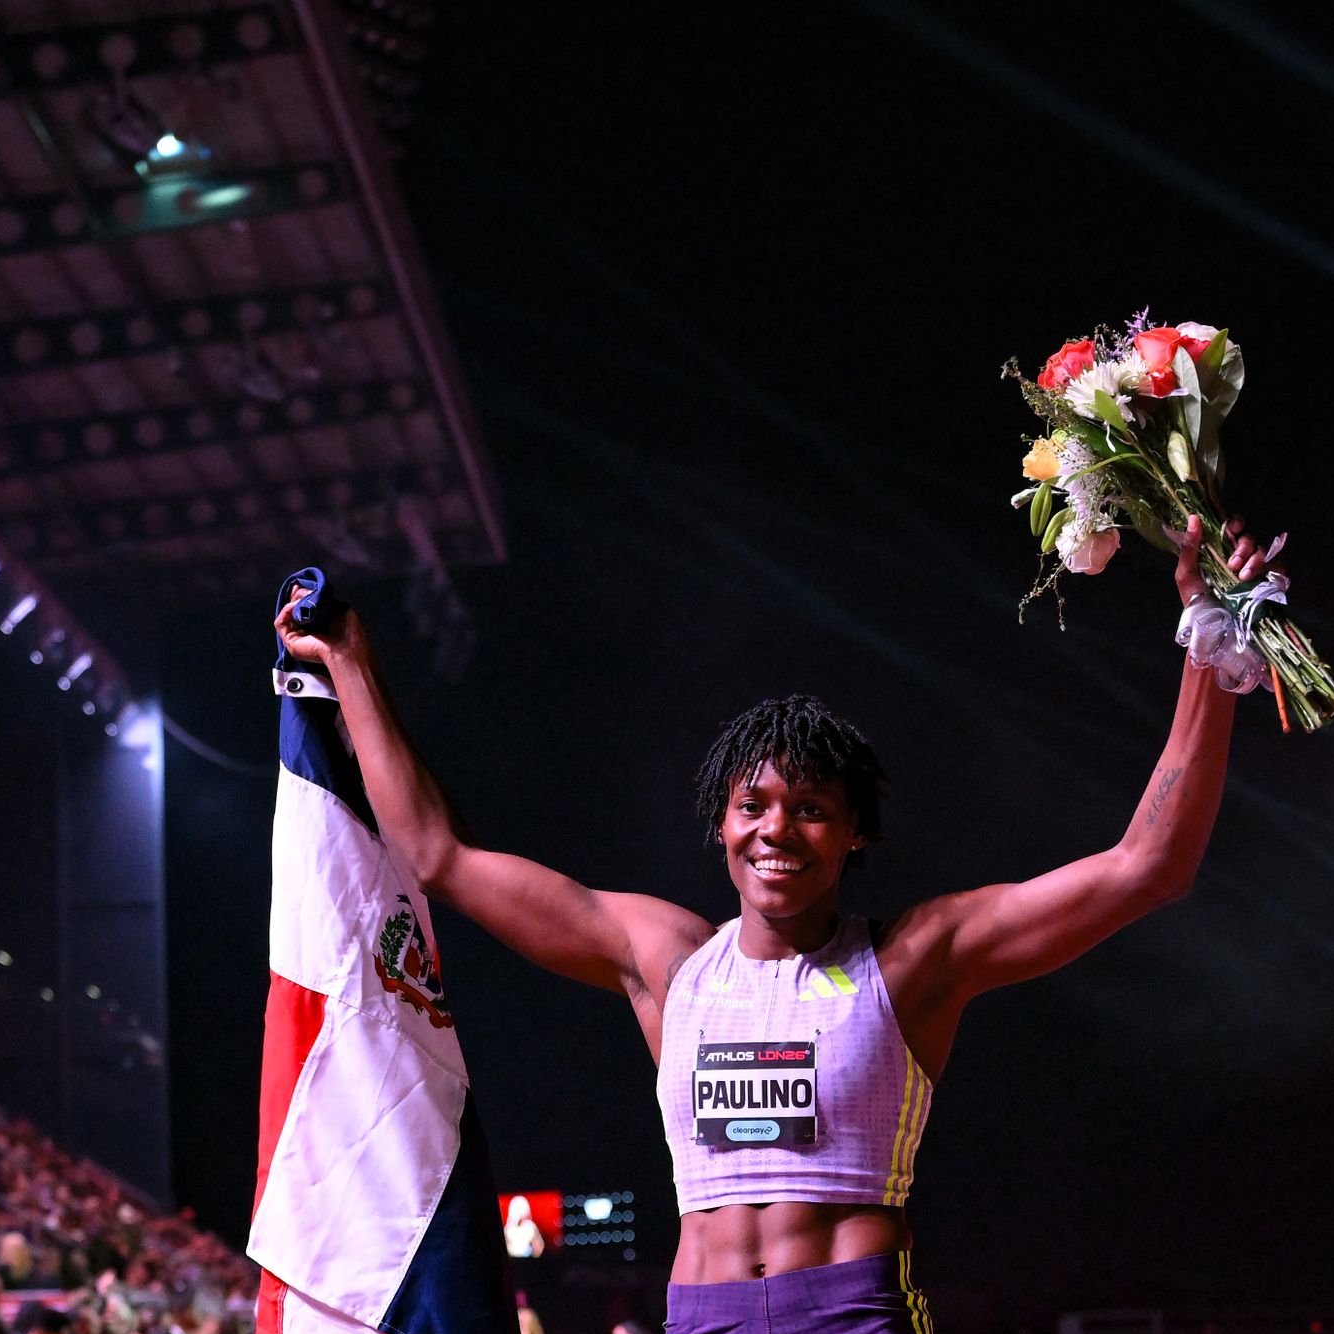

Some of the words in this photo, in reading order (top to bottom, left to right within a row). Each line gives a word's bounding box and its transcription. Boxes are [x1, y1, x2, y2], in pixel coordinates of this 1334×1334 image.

[704, 1051, 755, 1062] ATHLOS
[698, 1079, 812, 1109] PAULINO
[732, 1126, 764, 1136] clearpay
